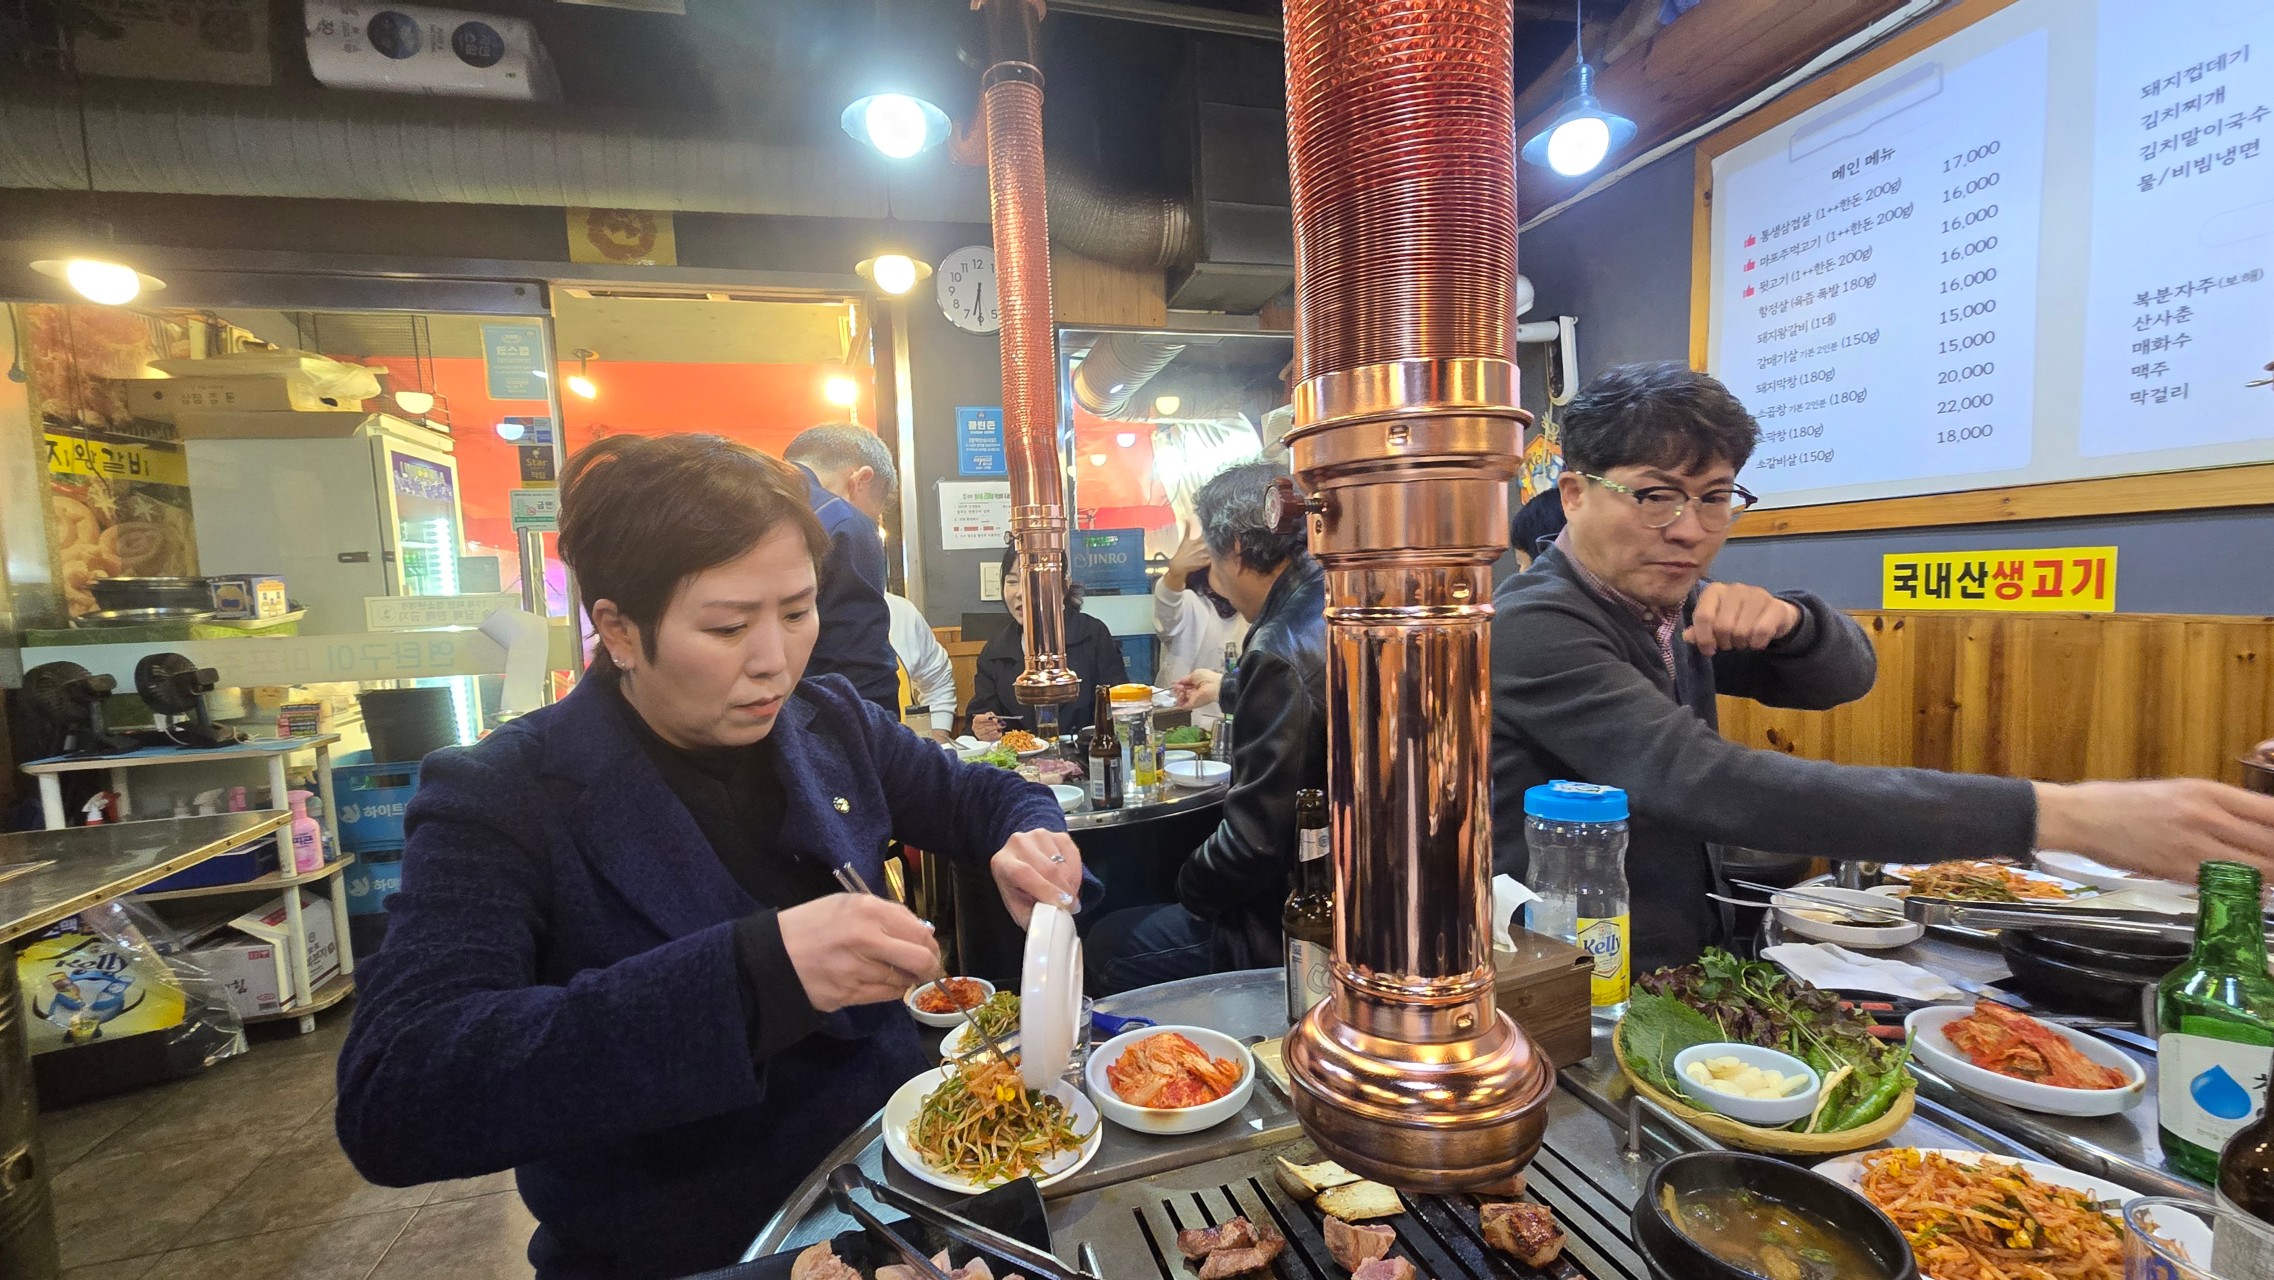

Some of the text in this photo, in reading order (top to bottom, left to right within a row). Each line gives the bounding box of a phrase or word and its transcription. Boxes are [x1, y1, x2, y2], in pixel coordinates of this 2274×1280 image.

[2140, 44, 2250, 99] 돼지껍데기
[2140, 85, 2226, 131] 김치찌개
[2139, 105, 2272, 162] 김치말이국수
[1832, 147, 1896, 180] 메인 메뉴
[1942, 140, 2000, 174] 17,000
[2136, 138, 2260, 192] 물/비빔냉면
[1942, 172, 2000, 203] 16,000
[1760, 177, 1902, 243] 통생삼겹살 (1++한돈 200g)
[1941, 204, 1999, 234] 16,000
[1759, 202, 1914, 266] 마포주먹고기 (1++한돈 200g)
[1940, 236, 1998, 265] 16,000
[972, 259, 984, 270] 12
[1791, 258, 1836, 283] (1++한돈
[1838, 245, 1873, 268] 200g)
[950, 272, 962, 282] 10
[1940, 268, 1998, 294] 16,000
[2133, 268, 2264, 308] 복분자주(보해)
[948, 286, 956, 296] 9
[1758, 299, 1788, 318] 항정살
[1817, 283, 1840, 300] 폭발
[1842, 272, 1877, 293] 180g)
[953, 299, 960, 309] 8
[964, 309, 970, 319] 7
[990, 310, 998, 320] 5
[1939, 300, 1996, 325] 15,000
[1756, 312, 1837, 344] 돼지왕갈비 (1대)
[2132, 305, 2194, 332] 산사춘
[1757, 348, 1798, 370] 갈매기살
[1841, 328, 1880, 350] (150g)
[1938, 330, 1996, 354] 15,000
[2132, 332, 2192, 355] 매화수
[1756, 367, 1836, 394] 돼지막창 (180g)
[1938, 362, 1994, 386] 20,000
[2131, 361, 2170, 379] 맥주
[1830, 387, 1868, 406] (180g)
[1937, 393, 1994, 415] 22,000
[2130, 382, 2189, 406] 막걸리
[1788, 423, 1824, 440] (180g)
[1937, 424, 1993, 444] 18,000
[1756, 448, 1834, 470] 소갈비살 (150g)
[1088, 552, 1128, 568] JINRO
[1893, 558, 2106, 600] 국내산생고기
[362, 803, 406, 818] 하이트
[1584, 933, 1621, 956] Kelly
[55, 952, 128, 974] Kelly
